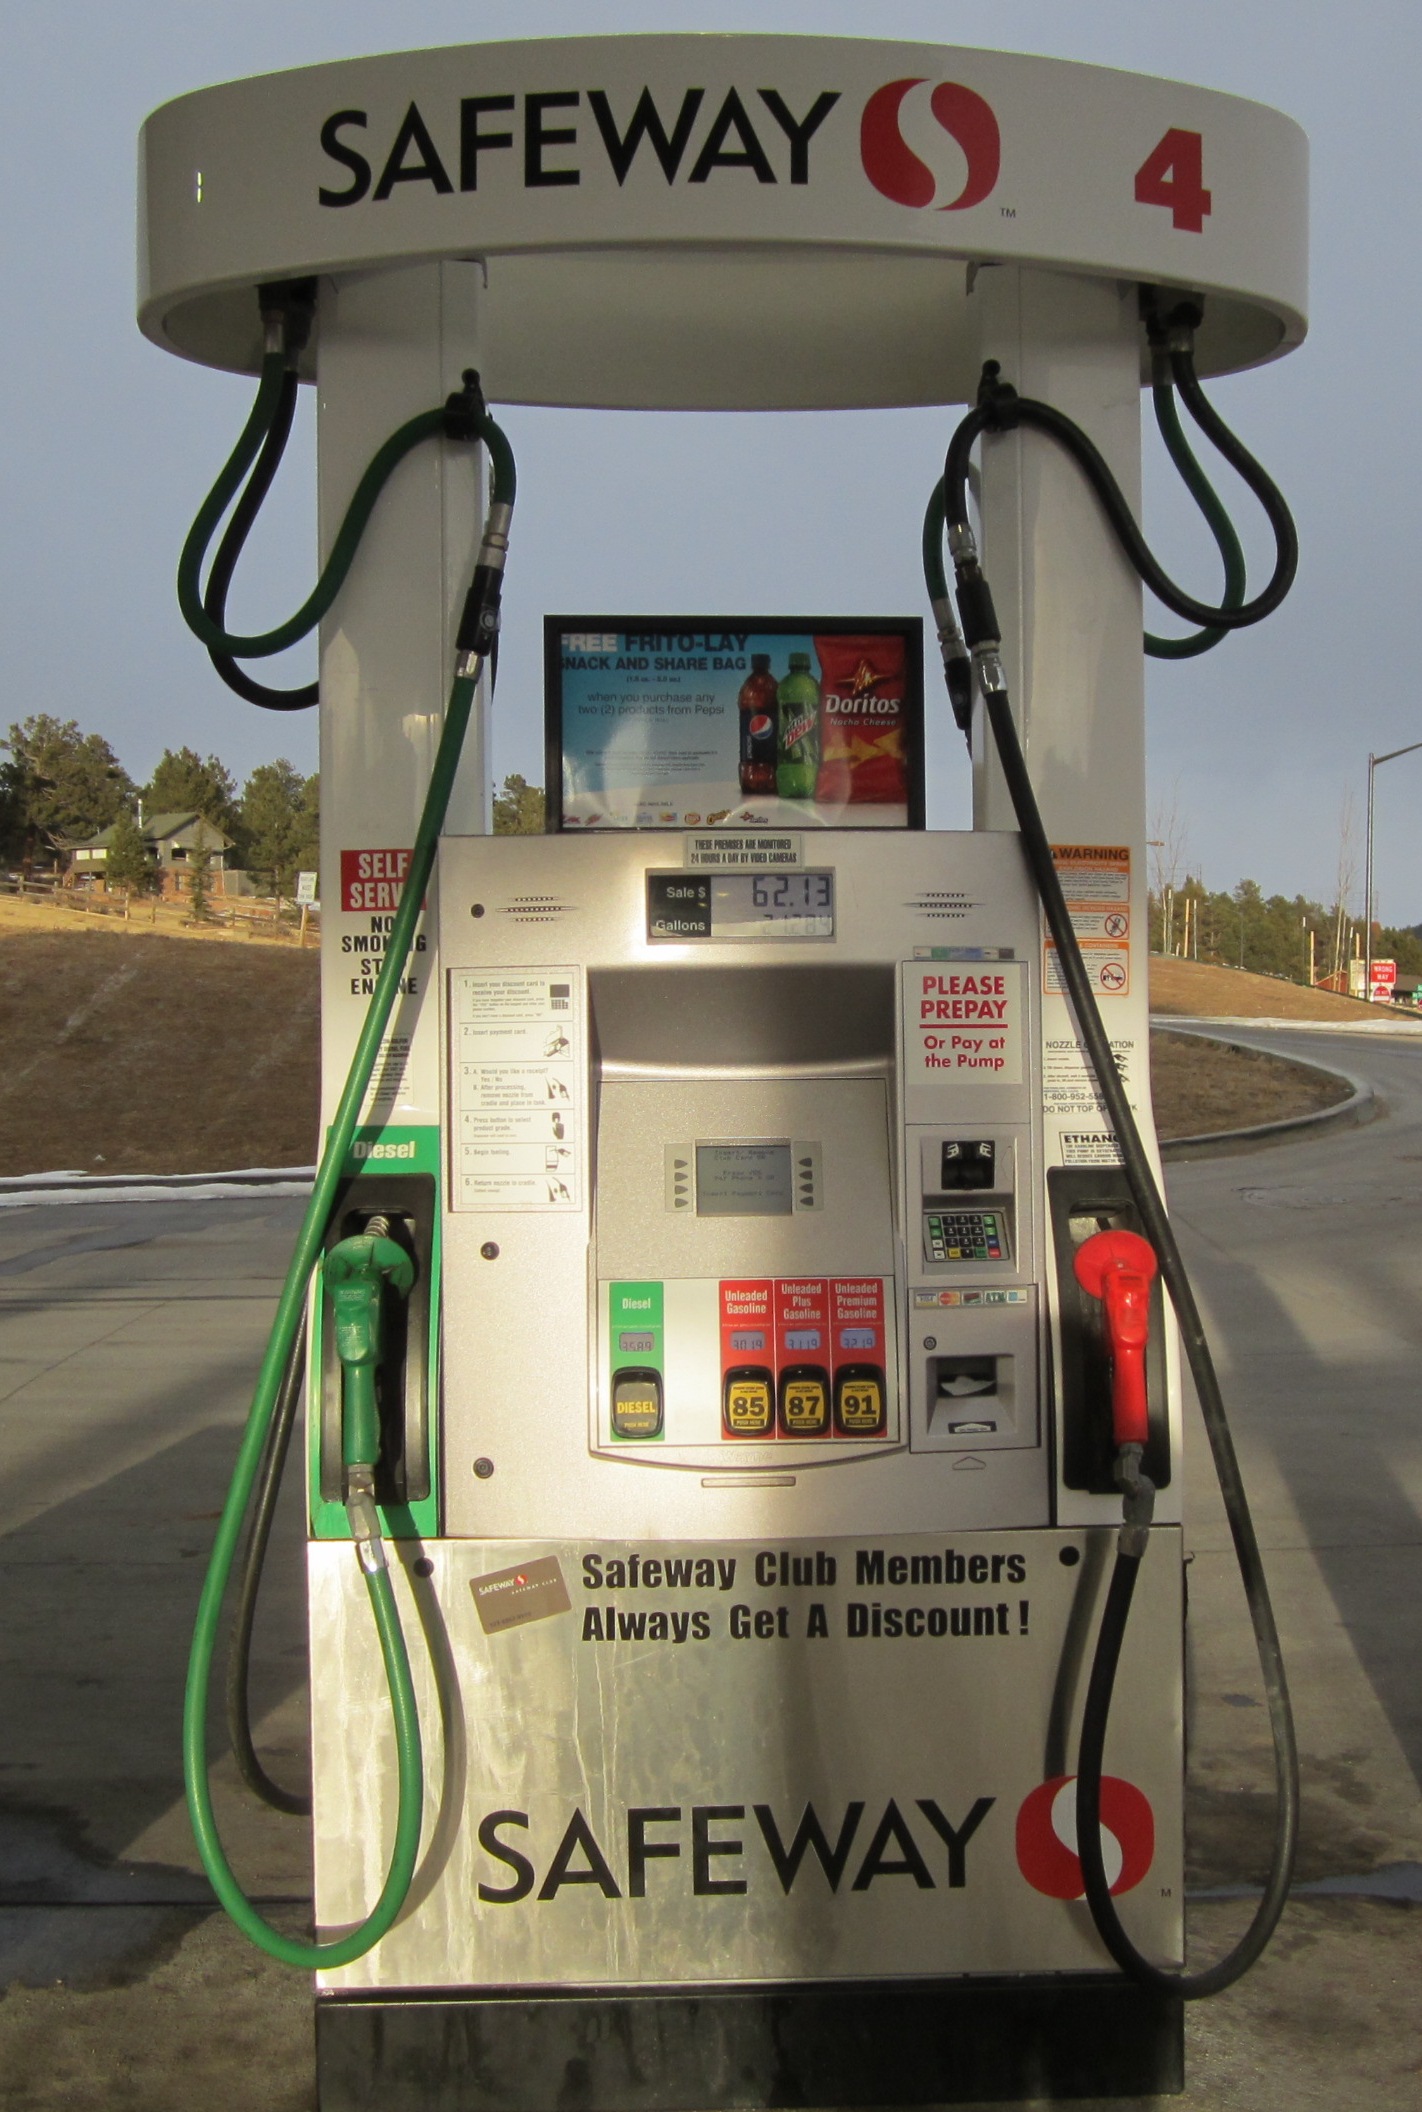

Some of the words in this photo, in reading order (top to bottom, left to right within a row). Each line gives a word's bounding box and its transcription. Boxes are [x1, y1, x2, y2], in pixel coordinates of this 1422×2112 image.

[317, 85, 842, 207] SAFEWAY
[1133, 125, 1212, 233] 4
[615, 657, 649, 670] AND
[654, 657, 708, 670] SHARE
[713, 657, 746, 670] BAG
[587, 693, 617, 702] when
[620, 695, 640, 704] you
[642, 692, 692, 704] purchase
[695, 694, 715, 704] any
[825, 693, 900, 714] Doritos
[578, 705, 598, 715] two
[600, 704, 615, 717] (2)
[667, 704, 692, 715] from
[695, 705, 725, 717] Pepsi
[830, 718, 859, 726] Nacho
[864, 718, 897, 726] Cheese
[695, 839, 713, 850] THESE
[714, 839, 743, 850] PREMISES
[745, 839, 756, 849] ARE
[757, 838, 791, 849] MONITORED
[691, 853, 699, 864] 24
[701, 853, 721, 863] HOURS
[722, 853, 727, 863] A
[728, 853, 739, 863] DAY
[740, 853, 749, 863] BY
[750, 853, 768, 863] VIDEO
[768, 852, 797, 863] CAMERAS
[1059, 847, 1129, 860] WARNING
[358, 852, 409, 879] SELF
[666, 887, 695, 898] Sale
[698, 886, 706, 899] $
[753, 876, 830, 907] 62.13
[656, 920, 706, 931] Gallons
[341, 935, 427, 953] SMOG
[922, 976, 1005, 995] PLEASE
[921, 1000, 1008, 1019] PREPAY
[924, 1035, 945, 1049] Or
[951, 1035, 983, 1053] Pay
[989, 1037, 1005, 1049] at
[1046, 1040, 1081, 1049] NOZZLE
[925, 1053, 951, 1068] the
[957, 1054, 1005, 1071] Pump
[1043, 1105, 1055, 1113] DO
[1057, 1105, 1075, 1113] NOT
[1077, 1105, 1094, 1113] TOP
[1064, 1134, 1119, 1144] ETHAN
[353, 1141, 416, 1159] Diesel
[781, 1283, 822, 1294] Unleaded
[835, 1283, 878, 1294] Unleaded
[725, 1290, 767, 1301] Unleaded
[792, 1296, 811, 1307] Plus
[837, 1295, 877, 1306] Premium
[622, 1298, 651, 1309] Diesel
[727, 1303, 767, 1314] Gasoline
[783, 1308, 821, 1320] Gasoline
[837, 1308, 877, 1319] Gasoline
[617, 1401, 656, 1414] DIESEL
[732, 1396, 765, 1417] 85
[788, 1396, 820, 1417] 87
[844, 1395, 877, 1416] 91
[582, 1553, 737, 1590] Safeway
[755, 1550, 837, 1587] Club
[855, 1548, 1026, 1586] Members
[478, 1579, 515, 1596] SAFEWAY
[582, 1606, 712, 1645] Always
[729, 1605, 788, 1640] Get
[807, 1603, 829, 1639] A
[476, 1798, 996, 1904] SAFEWAY
